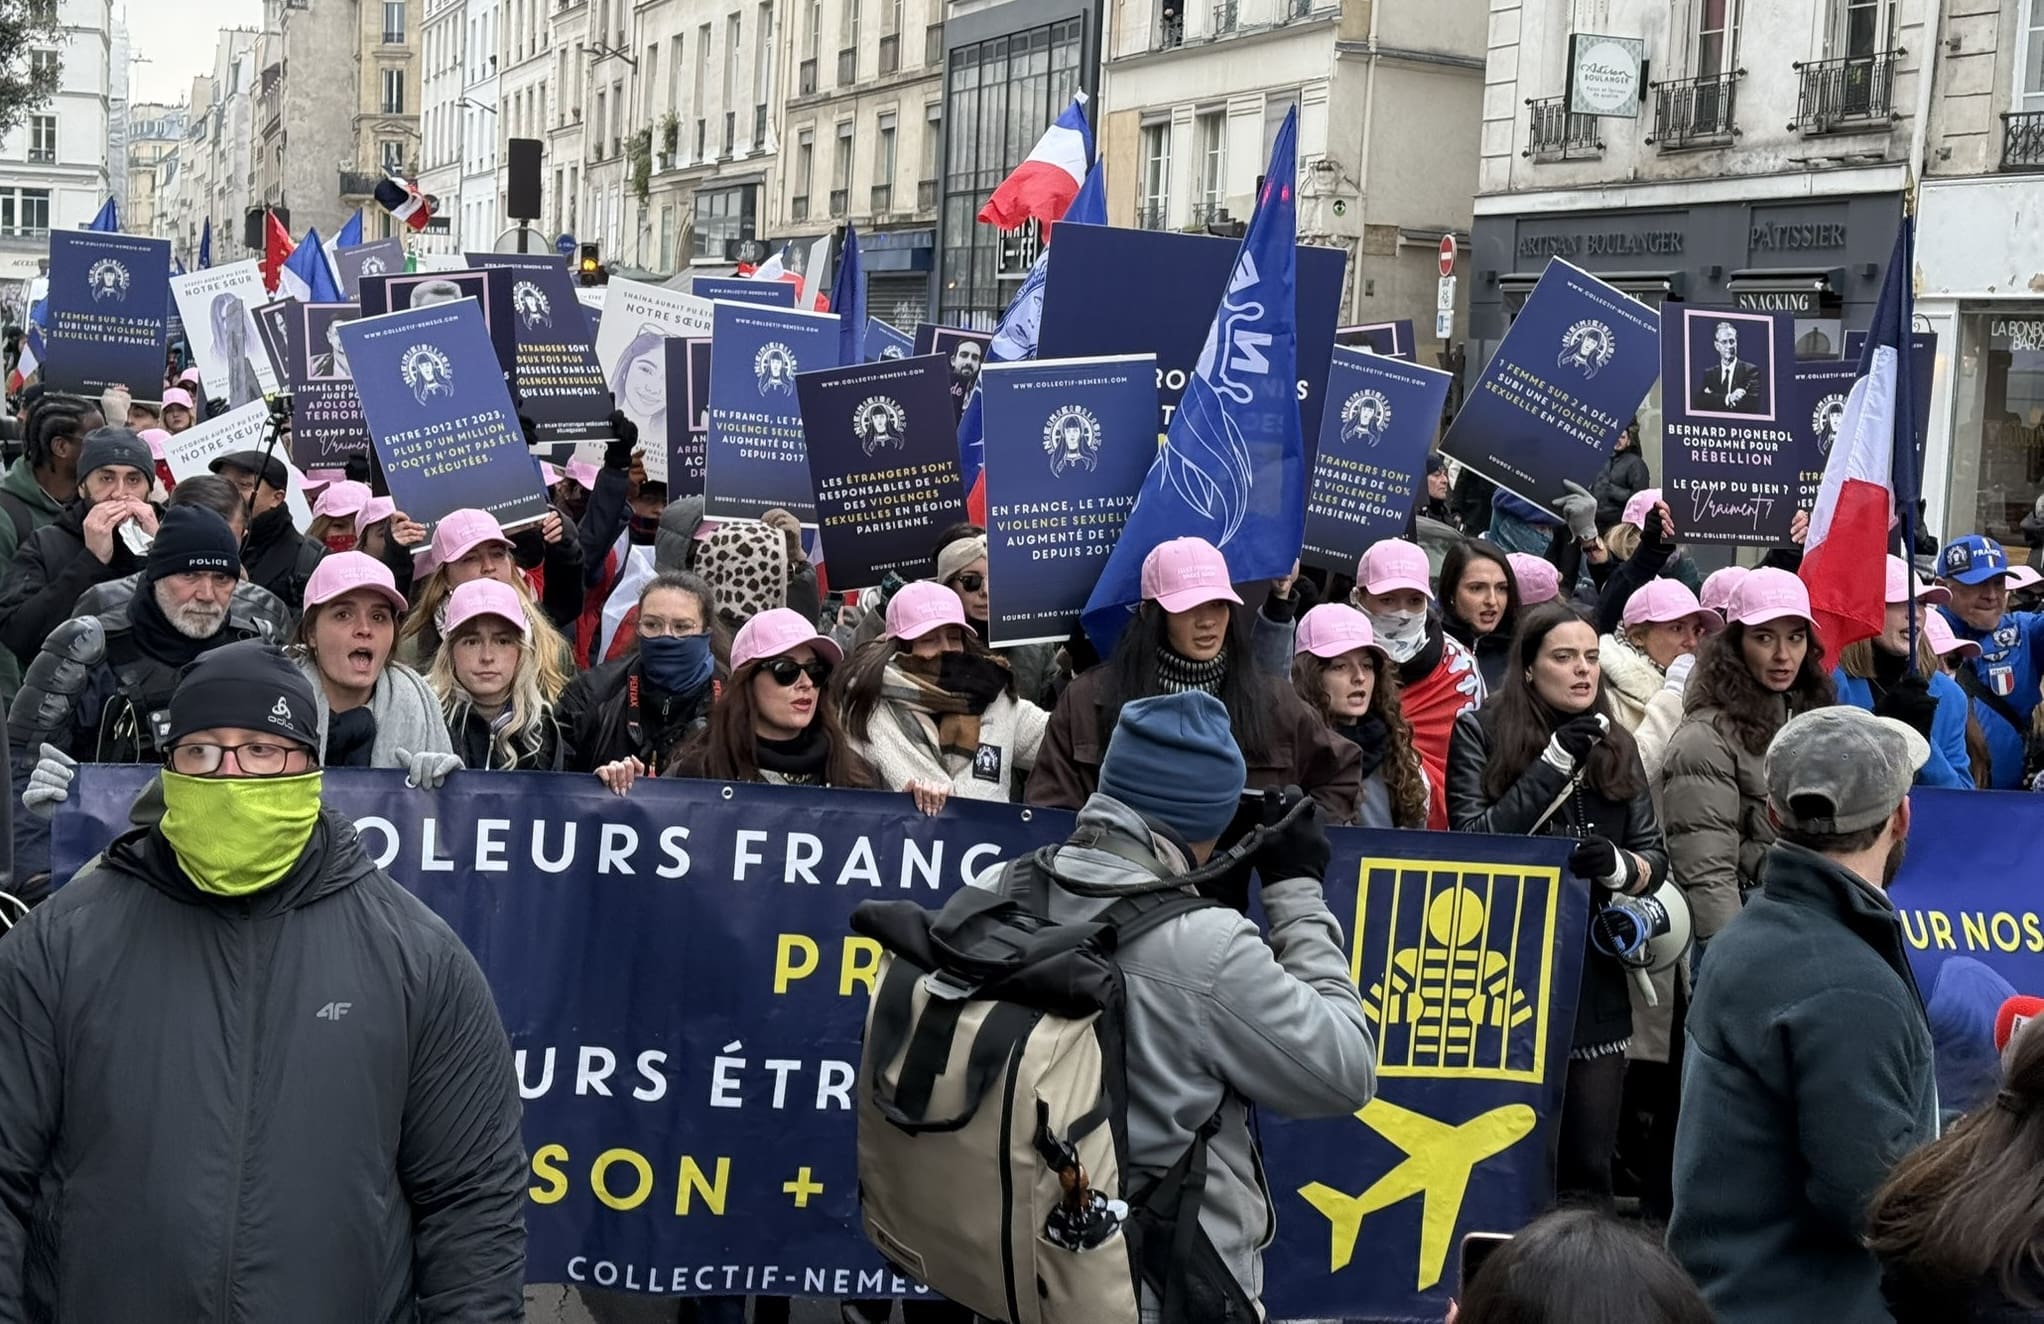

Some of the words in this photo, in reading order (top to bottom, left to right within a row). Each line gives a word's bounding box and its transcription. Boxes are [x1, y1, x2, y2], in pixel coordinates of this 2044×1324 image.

[1517, 234, 1579, 257] ARTISAN
[1587, 231, 1684, 255] BOULANGER
[185, 282, 221, 296] NOTRE
[623, 291, 653, 305] SHAÏNA
[1739, 293, 1809, 312] SNACKING
[61, 312, 94, 322] FEMME
[98, 315, 116, 324] SUR
[137, 317, 161, 328] DÉJÀ
[626, 303, 671, 322] NOTRE
[674, 315, 712, 331] SŒUR
[58, 321, 81, 331] SUBI
[84, 322, 103, 332] UNE
[106, 323, 155, 337] VIOLENCE
[1991, 321, 2007, 337] LA
[53, 330, 99, 342] SEXUELLE
[103, 334, 115, 343] EN
[118, 335, 160, 347] FRANCE.
[2012, 335, 2036, 351] BAR
[518, 343, 567, 353] ÉTRANGERS
[568, 344, 589, 353] SONT
[517, 355, 539, 363] DEUX
[541, 355, 560, 363] FOIS
[562, 355, 583, 363] PLUS
[564, 366, 585, 374] DANS
[587, 365, 600, 374] LES
[298, 383, 332, 392] ISMAËL
[517, 376, 557, 386] OLENCES
[559, 375, 603, 385] SEXUELLES
[1012, 376, 1128, 390] WWW.COLLECTIF-NEMESIS.COM
[321, 391, 345, 399] JUGÉ
[519, 388, 537, 398] QUE
[539, 387, 554, 396] LES
[556, 387, 600, 397] FRANÇAIS.
[1506, 363, 1545, 390] FEMME
[1548, 385, 1569, 403] SUR
[1571, 398, 1579, 408] 2
[1580, 404, 1588, 413] A
[1591, 406, 1619, 430] DÉJÀ
[1498, 373, 1524, 393] SUBI
[1526, 388, 1548, 405] UNE
[1551, 401, 1607, 437] VIOLENCE
[713, 409, 726, 419] EN
[729, 411, 773, 424] FRANCE,
[777, 415, 789, 425] LE
[1484, 380, 1539, 415] SEXUELLE
[1540, 411, 1555, 424] EN
[1557, 419, 1604, 452] FRANCE.
[300, 429, 311, 437] LE
[315, 428, 345, 437] CAMP
[349, 428, 363, 436] DU
[384, 428, 422, 446] ENTRE
[424, 422, 452, 438] 2012
[456, 418, 468, 429] ET
[472, 410, 505, 426] 2023,
[716, 422, 768, 436] VIOLENCE
[1668, 424, 1727, 438] BERNARD
[1730, 428, 1793, 443] PIGNEROL
[393, 442, 422, 457] PLUS
[425, 435, 454, 449] D'UN
[457, 423, 505, 444] MILLION
[691, 434, 707, 443] AN
[722, 435, 779, 449] AUGMENTÉ
[782, 440, 795, 449] DE
[1683, 436, 1746, 450] CONDAMNÉ
[1750, 441, 1778, 452] POUR
[181, 437, 224, 464] NOTRE
[388, 454, 432, 473] D'OQTF
[436, 445, 471, 461] N'ONT
[475, 439, 496, 452] PAS
[499, 431, 519, 446] ÉTÉ
[740, 449, 777, 461] DEPUIS
[779, 452, 804, 463] 2017
[1692, 449, 1773, 465] RÉBELLION
[424, 454, 493, 478] EXÉCUTÉES.
[822, 477, 843, 489] LES
[846, 466, 918, 486] ÉTRANGERS
[922, 461, 954, 474] SONT
[1381, 468, 1411, 483] SONT
[819, 480, 912, 501] RESPONSABLES
[915, 478, 931, 488] DE
[934, 474, 960, 485] 40%
[1325, 481, 1387, 504] VIOLENCES
[1370, 479, 1385, 490] DE
[1387, 483, 1411, 496] 40%
[1673, 479, 1687, 489] LE
[1690, 480, 1727, 491] CAMP
[1731, 482, 1748, 492] DU
[1752, 483, 1779, 494] BIEN
[843, 500, 866, 511] DES
[870, 489, 940, 507] VIOLENCES
[992, 504, 1008, 516] EN
[1014, 500, 1074, 515] FRANCE,
[1079, 499, 1094, 510] LE
[1098, 495, 1134, 508] TAUX
[824, 509, 892, 527] SEXUELLES
[895, 507, 911, 517] EN
[914, 499, 962, 514] RÉGION
[1341, 498, 1355, 509] EN
[1358, 500, 1403, 521] RÉGION
[856, 518, 934, 535] PARISIENNE.
[997, 516, 1067, 531] VIOLENCE
[1006, 528, 1084, 547] AUGMENTÉ
[1088, 529, 1105, 540] DE
[1032, 546, 1081, 560] DEPUIS
[189, 558, 228, 567] POLICE
[1002, 612, 1031, 622] SOURCE
[353, 816, 691, 880] OLEURS
[1900, 909, 1957, 951] UR
[1960, 911, 2044, 953] NOS
[773, 933, 883, 997] PR
[316, 1002, 352, 1021] 4F
[515, 1045, 668, 1102] URS
[710, 1040, 857, 1110] ÉTR
[528, 1143, 731, 1217] SON
